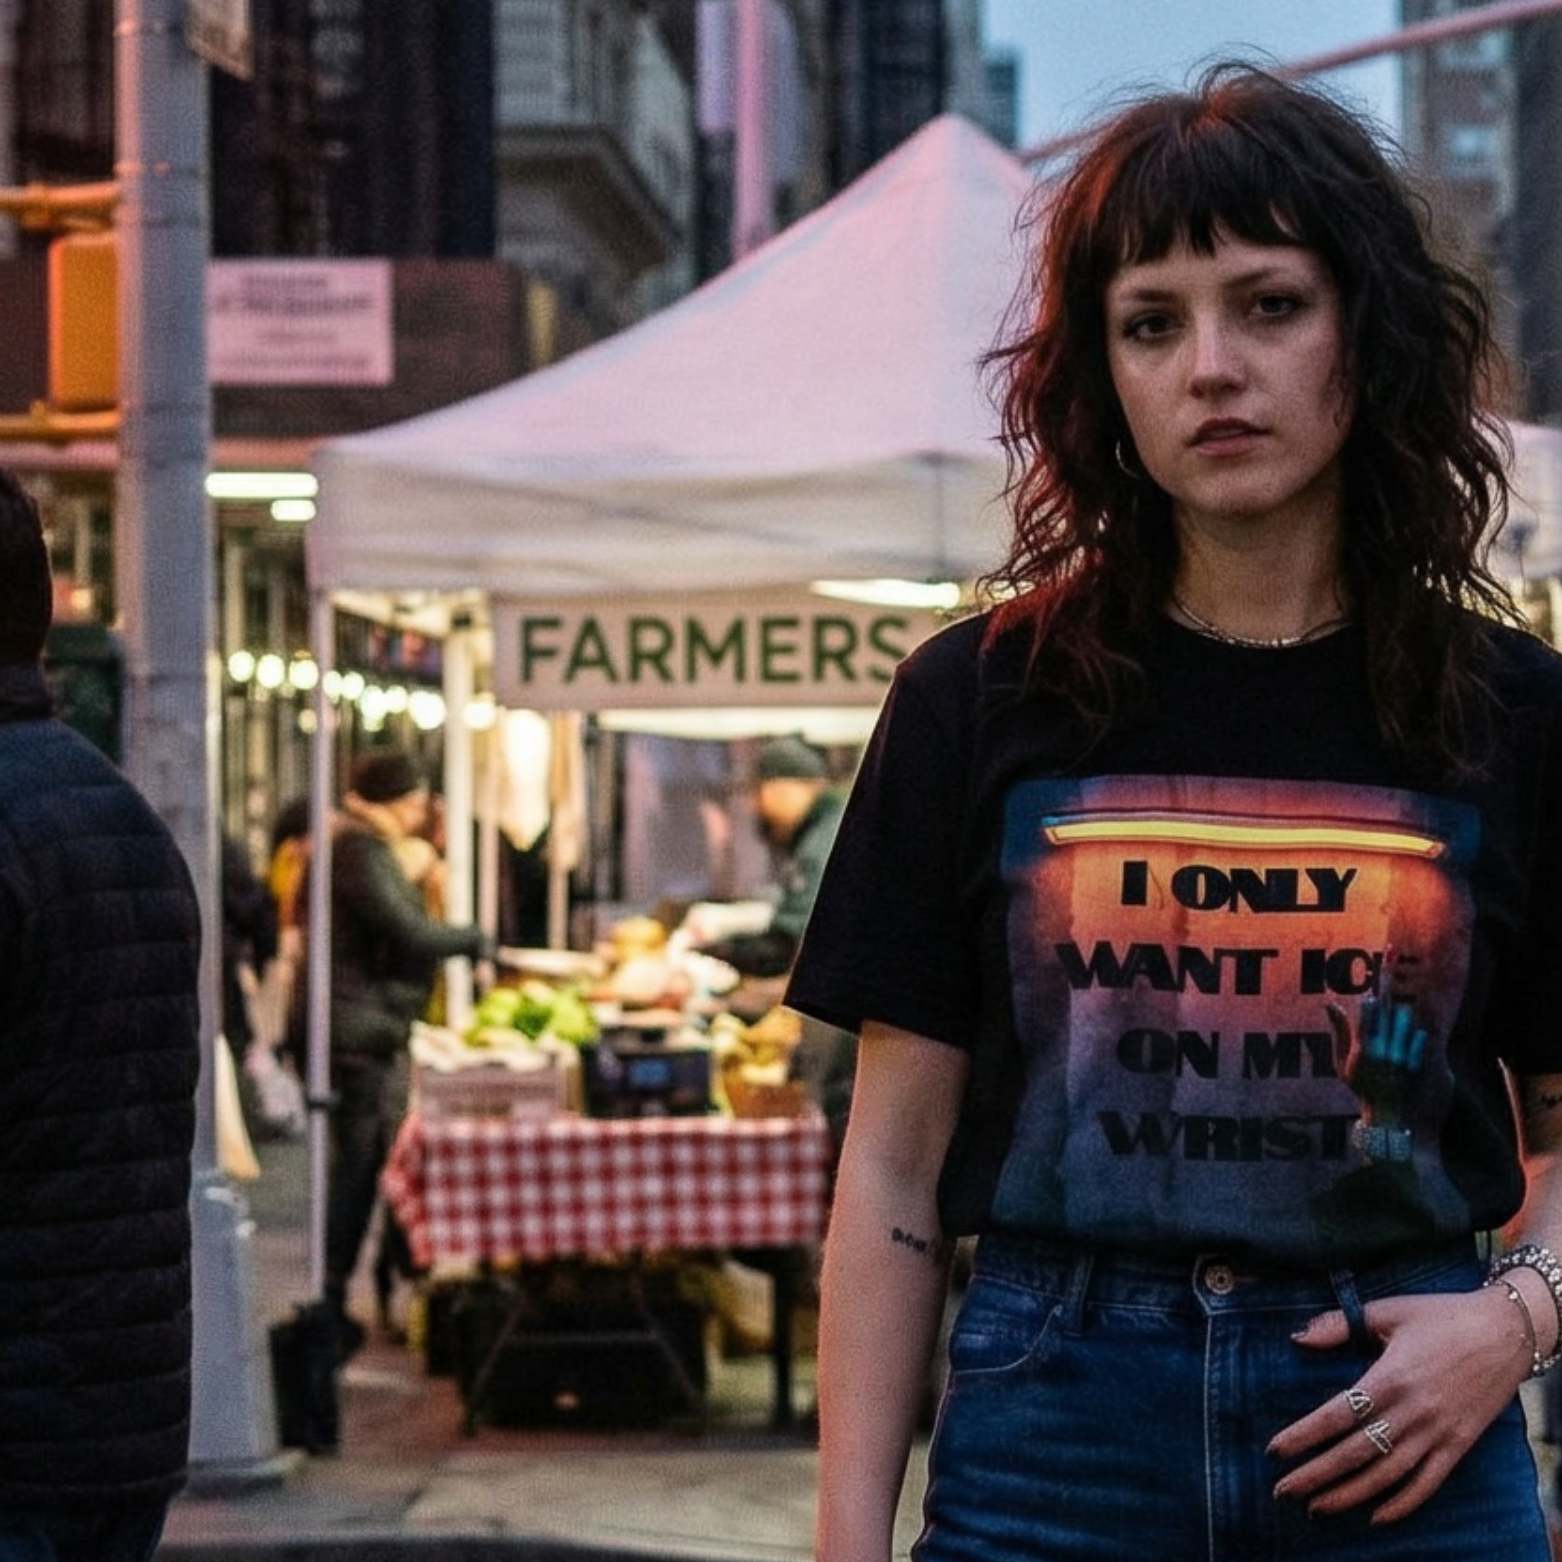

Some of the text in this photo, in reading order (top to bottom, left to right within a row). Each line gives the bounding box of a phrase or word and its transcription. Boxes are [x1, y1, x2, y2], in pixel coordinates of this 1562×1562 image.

[519, 614, 909, 684] FARMERS
[1121, 860, 1358, 914] I ONLY
[1053, 940, 1280, 995] WANT
[1115, 1028, 1220, 1079] ON
[1096, 1110, 1362, 1162] WRIST
